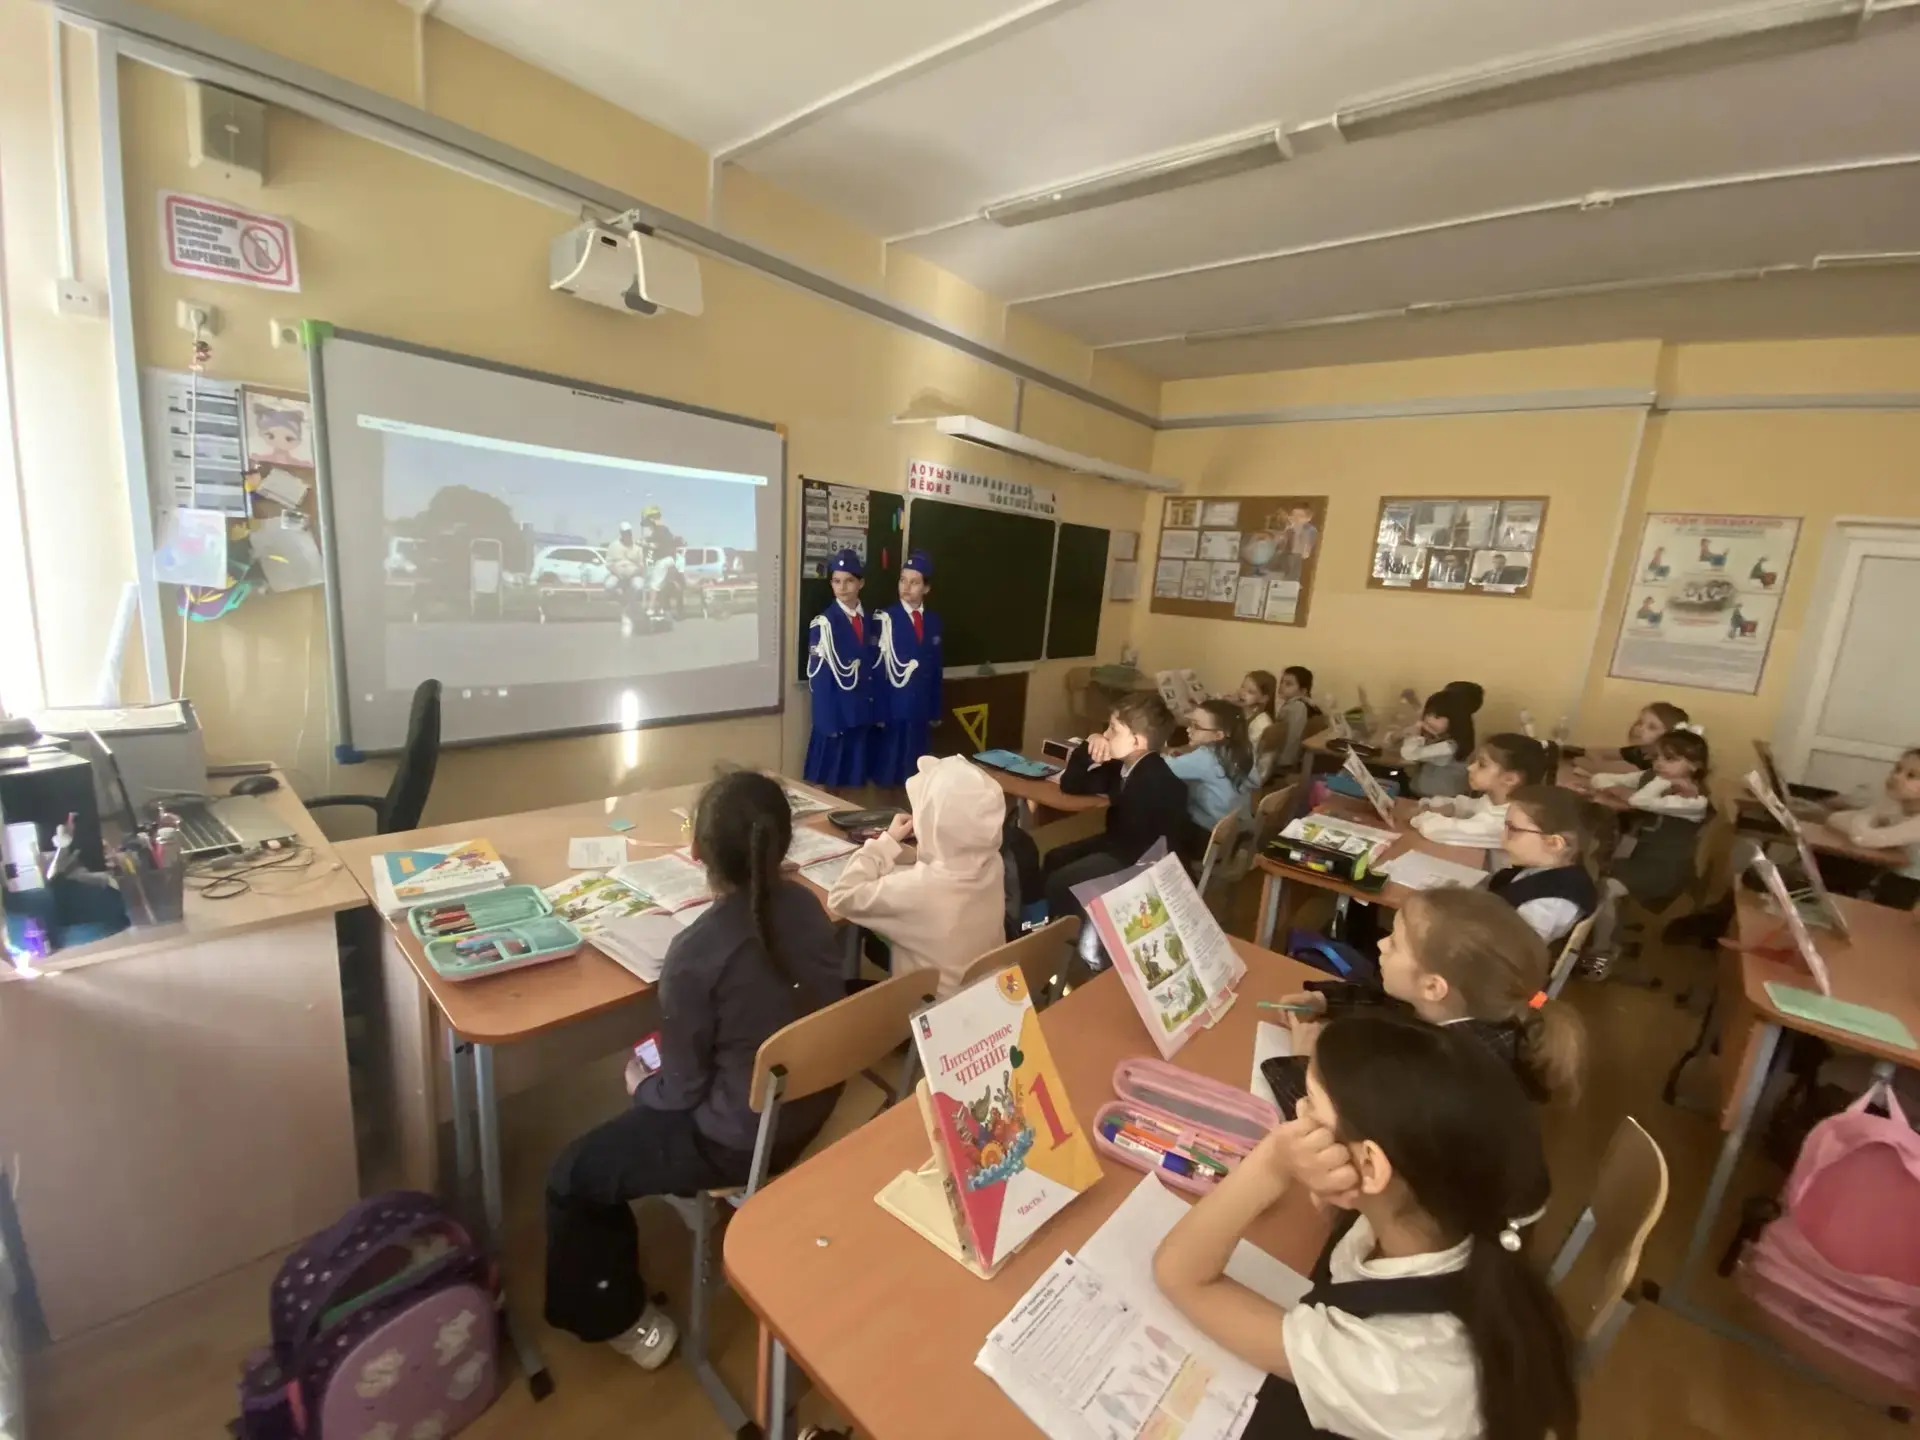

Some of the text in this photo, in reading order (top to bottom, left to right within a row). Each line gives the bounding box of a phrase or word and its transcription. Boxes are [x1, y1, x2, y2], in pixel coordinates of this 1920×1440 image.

[939, 1023, 1013, 1076] Литературное
[955, 1044, 1009, 1087] ЧТЕНИЕ
[1028, 1072, 1073, 1151] 1
[1017, 1196, 1042, 1216] Часть
